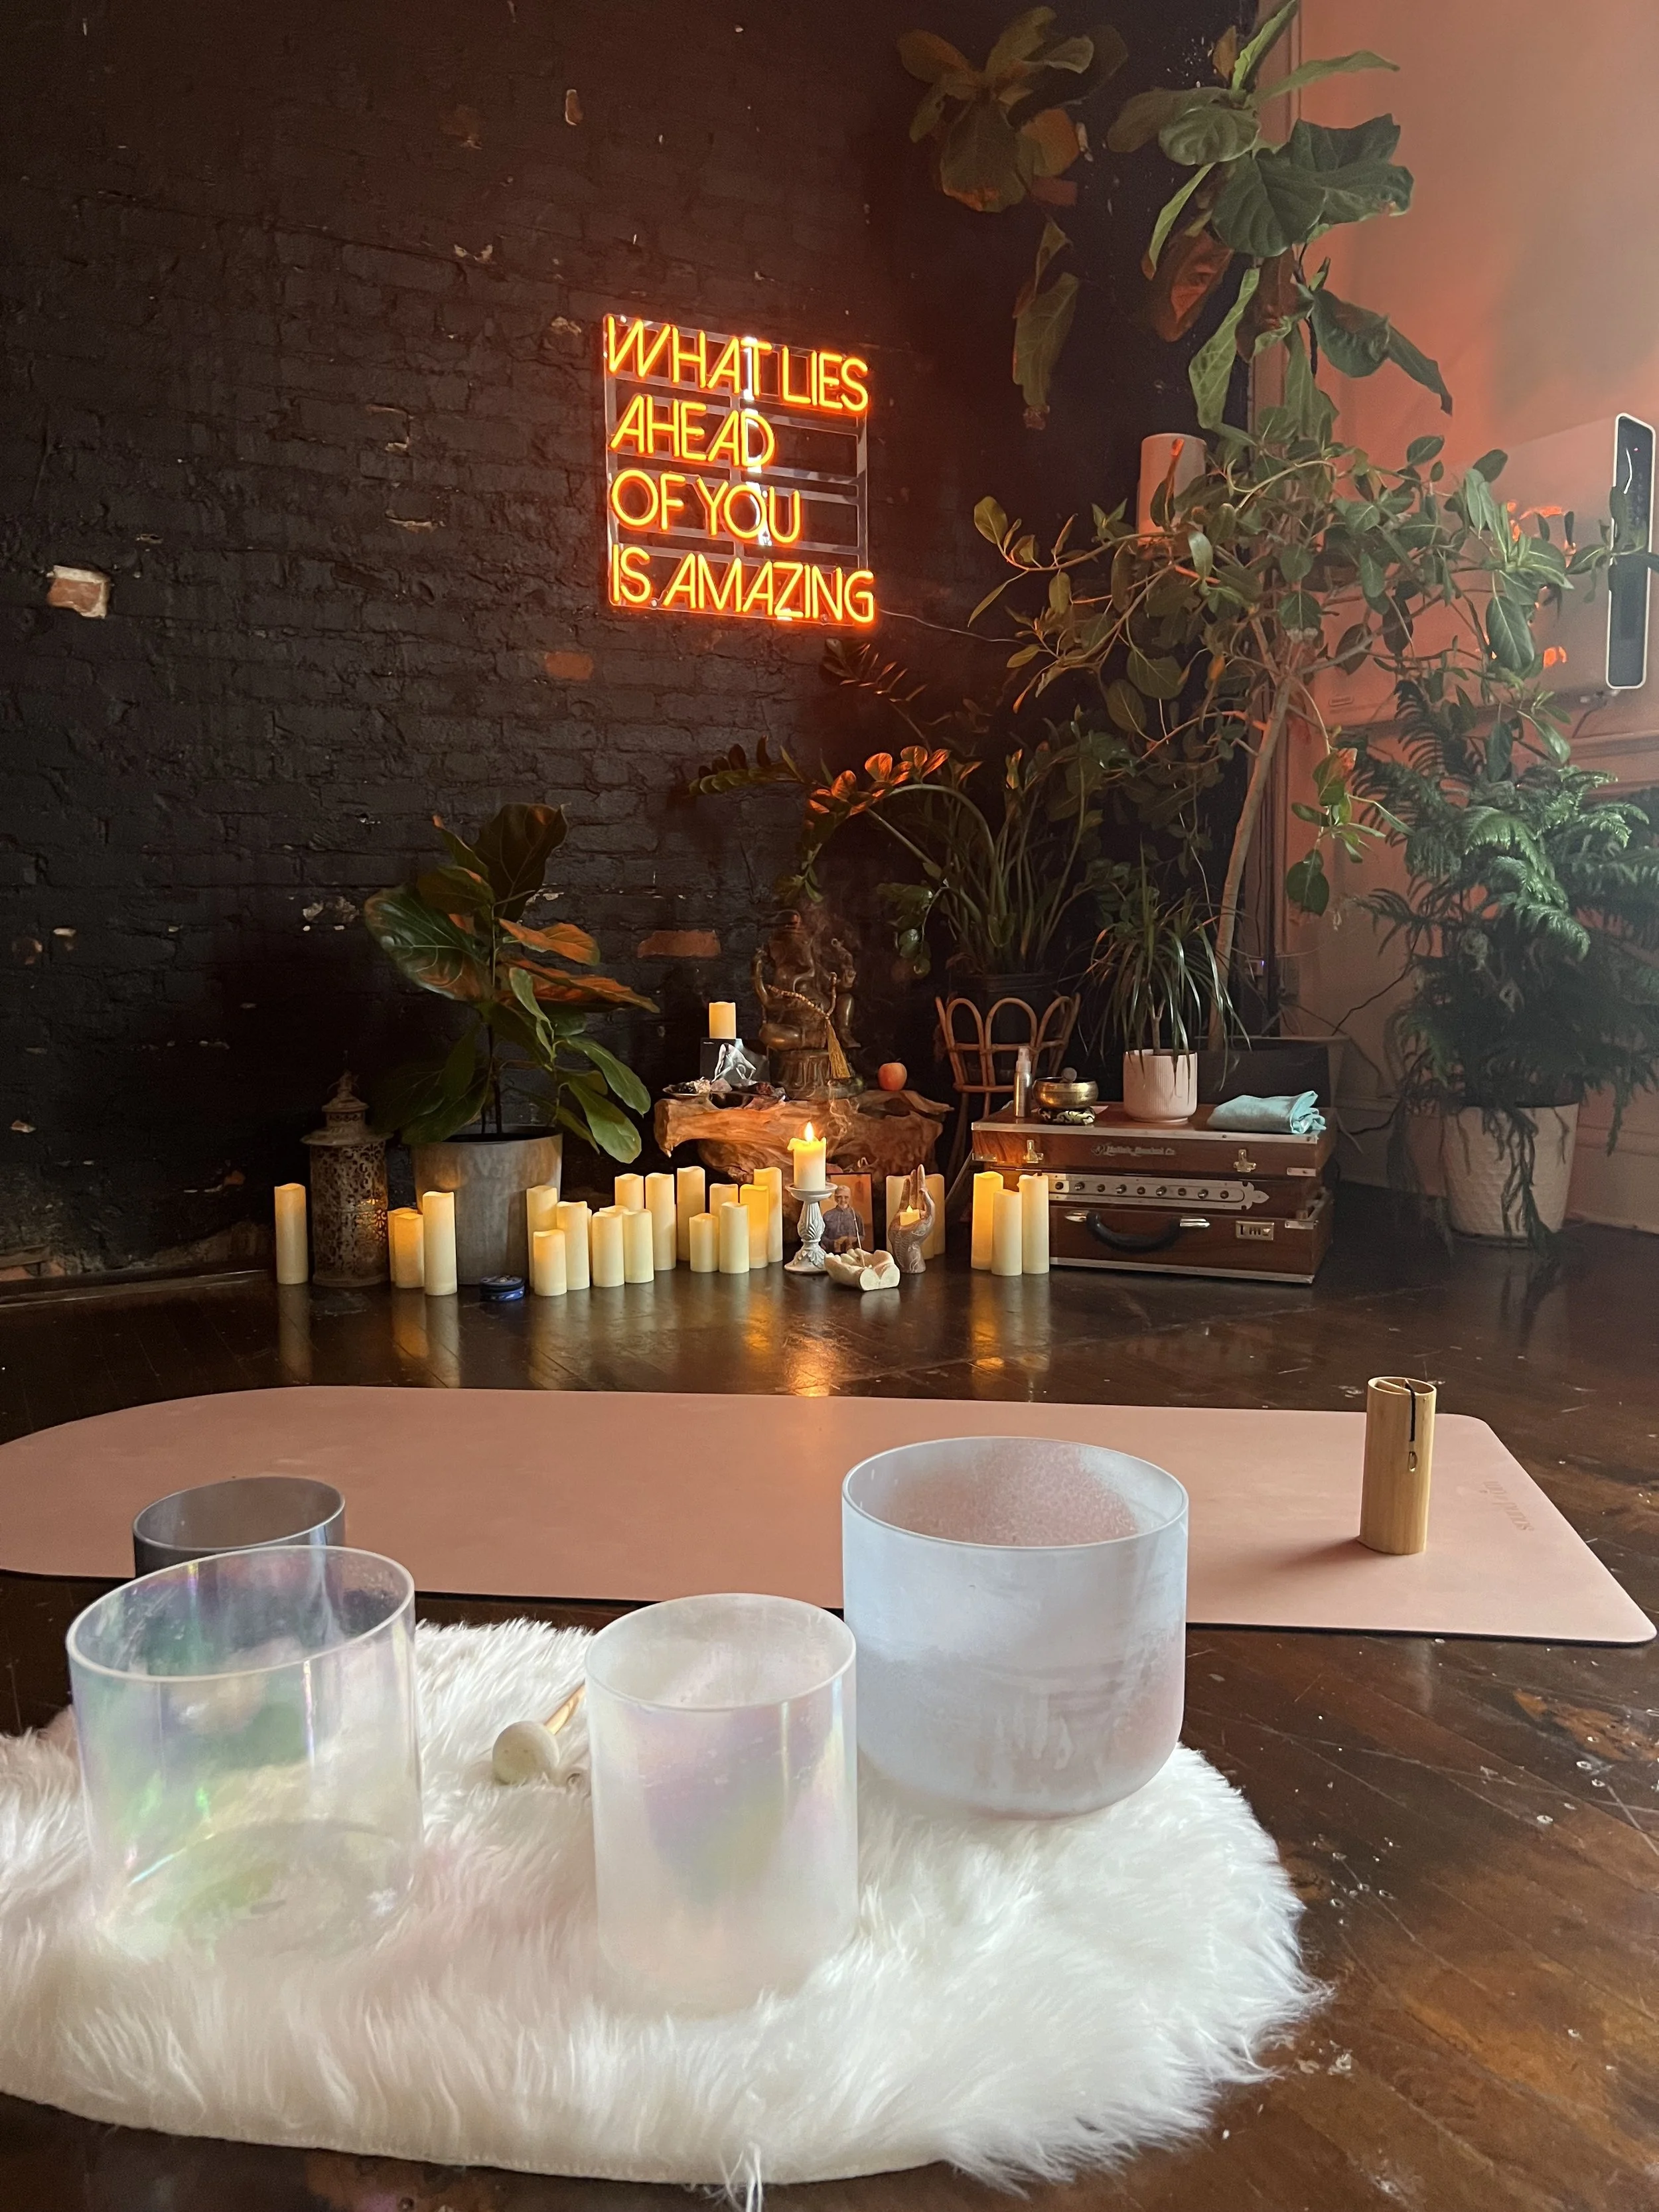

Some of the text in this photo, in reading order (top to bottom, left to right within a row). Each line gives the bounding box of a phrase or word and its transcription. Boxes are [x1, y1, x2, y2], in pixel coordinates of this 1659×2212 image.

[607, 315, 869, 411] WHAT LIES
[610, 394, 775, 467] AHEAD
[611, 469, 801, 543] OF YOU
[612, 544, 875, 623] IS AMAZING
